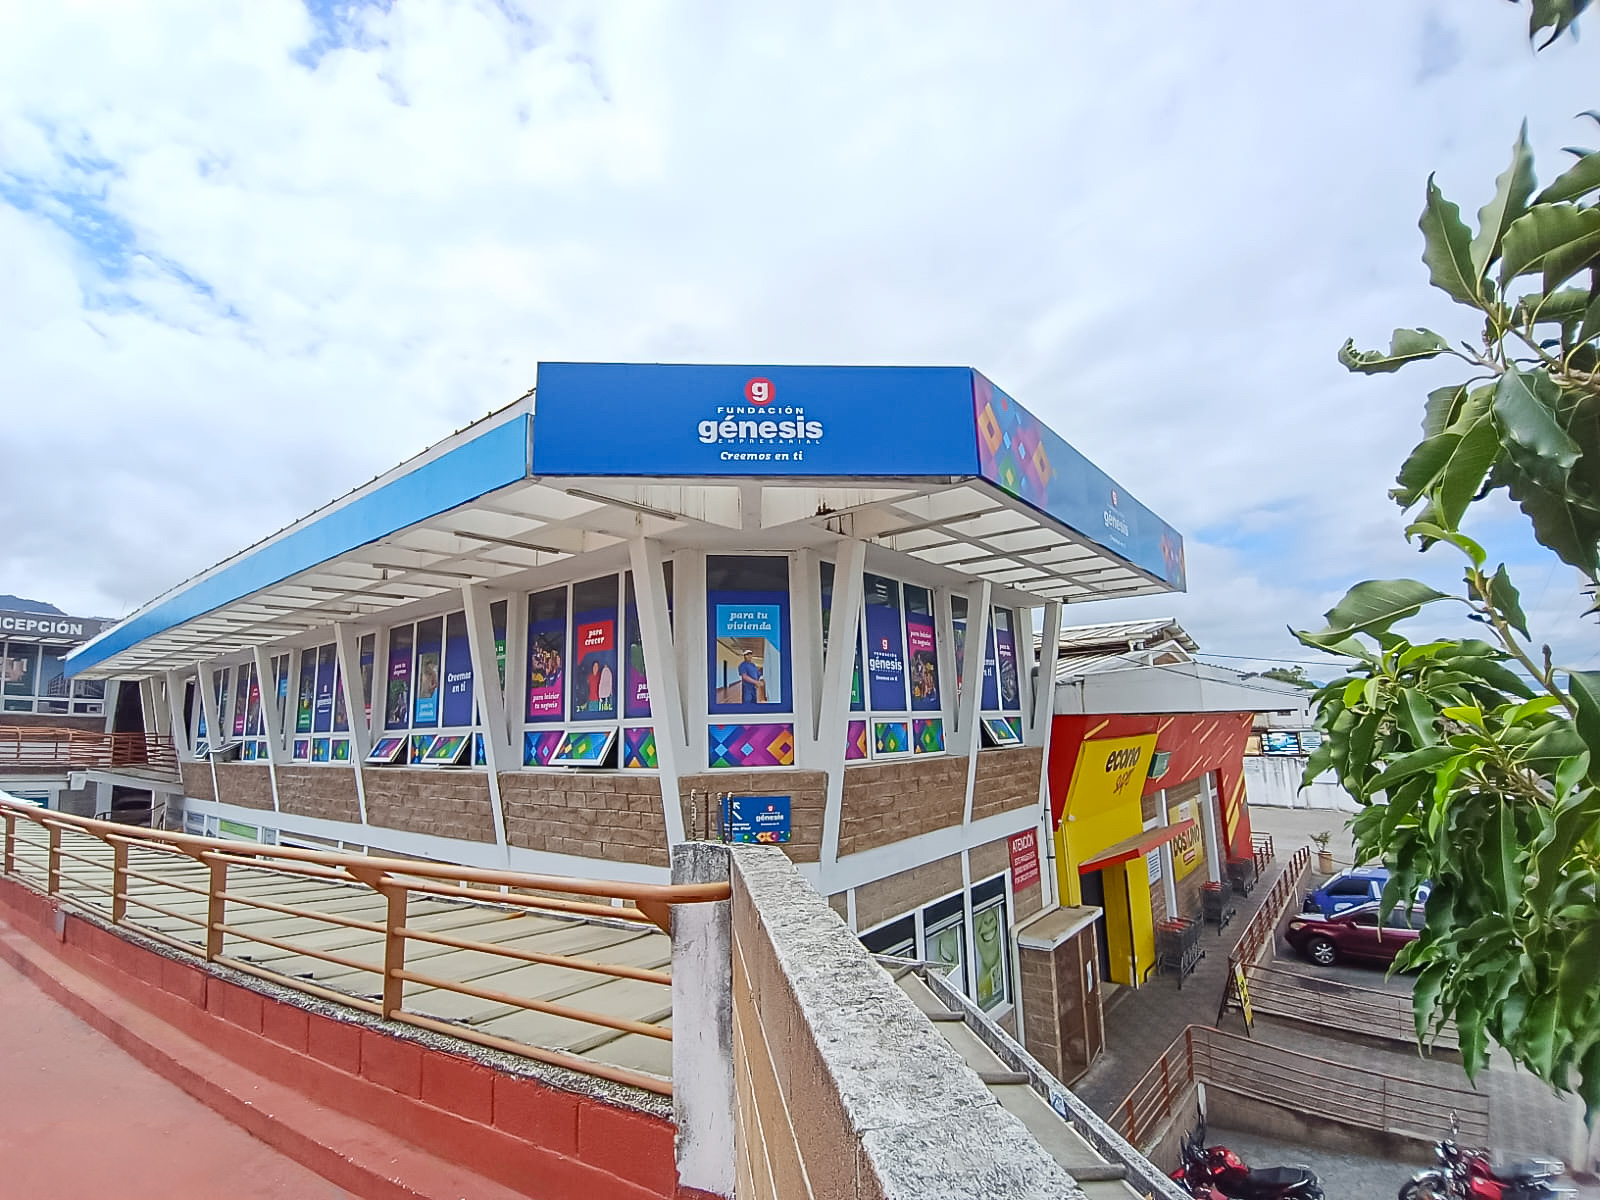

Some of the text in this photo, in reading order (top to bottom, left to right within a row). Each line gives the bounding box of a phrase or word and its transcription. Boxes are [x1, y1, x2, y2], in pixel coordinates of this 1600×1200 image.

[751, 382, 769, 402] g
[717, 405, 804, 415] FUNDACIÓN
[698, 415, 824, 444] génesis
[720, 450, 804, 461] Creemos en ti
[729, 611, 768, 622] para tu
[727, 621, 772, 631] vivienda
[588, 628, 603, 639] para
[584, 636, 605, 646] crecer
[869, 656, 902, 672] génesis
[447, 671, 472, 683] Creemos
[1105, 745, 1142, 774] econo
